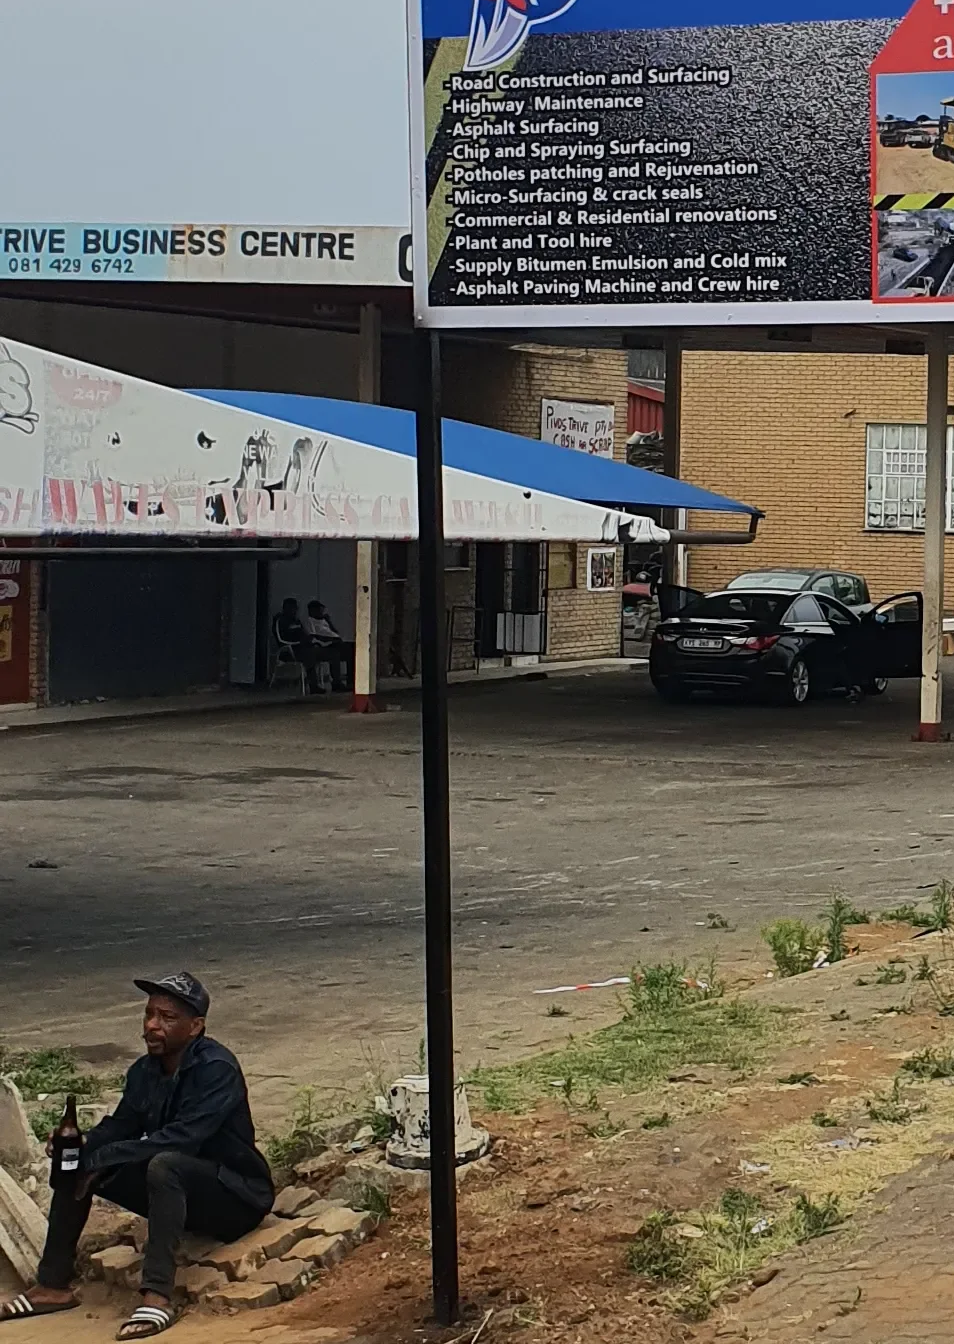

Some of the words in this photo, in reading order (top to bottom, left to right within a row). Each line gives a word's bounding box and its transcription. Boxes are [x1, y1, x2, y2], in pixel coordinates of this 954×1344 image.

[445, 74, 494, 91] -Road
[498, 71, 606, 89] Construction
[611, 69, 643, 85] and
[648, 67, 730, 86] Surfacing
[446, 97, 525, 116] -Highway
[534, 94, 644, 111] Maintenance
[446, 120, 515, 139] -Asphalt
[519, 118, 599, 137] Surfacing
[446, 143, 490, 162] -Chip
[495, 142, 526, 158] and
[530, 141, 605, 160] Spraying
[609, 138, 691, 156] Surfacing
[447, 166, 526, 182] -Potholes
[530, 164, 603, 184] patching
[608, 161, 640, 178] and
[645, 160, 758, 181] Rejuvenation
[447, 187, 587, 205] -Micro-Surfacing
[592, 187, 608, 202] &
[612, 185, 657, 201] crack
[661, 184, 703, 200] seals
[448, 210, 552, 228] -Commercial
[557, 211, 573, 226] &
[577, 208, 670, 225] Residential
[675, 207, 778, 223] renovations
[0, 228, 65, 253] RIVE
[83, 229, 226, 256] BUSINESS
[241, 230, 355, 261] CENTRE
[449, 235, 498, 250] -Plant
[502, 234, 533, 250] and
[537, 233, 575, 249] Tool
[579, 232, 613, 248] hire
[8, 258, 40, 273] 081
[49, 258, 81, 273] 429
[91, 258, 134, 273] 6742
[449, 257, 512, 276] -Supply
[517, 256, 587, 272] Bitumen
[592, 254, 668, 271] Emulsion
[673, 253, 705, 269] and
[710, 253, 750, 268] Cold
[755, 252, 787, 268] mix
[450, 280, 519, 299] -Asphalt
[524, 279, 580, 298] Paving
[585, 277, 656, 294] Machine
[660, 276, 693, 293] and
[698, 277, 741, 292] Crew
[746, 275, 780, 291] hire
[73, 388, 110, 401] 24/7
